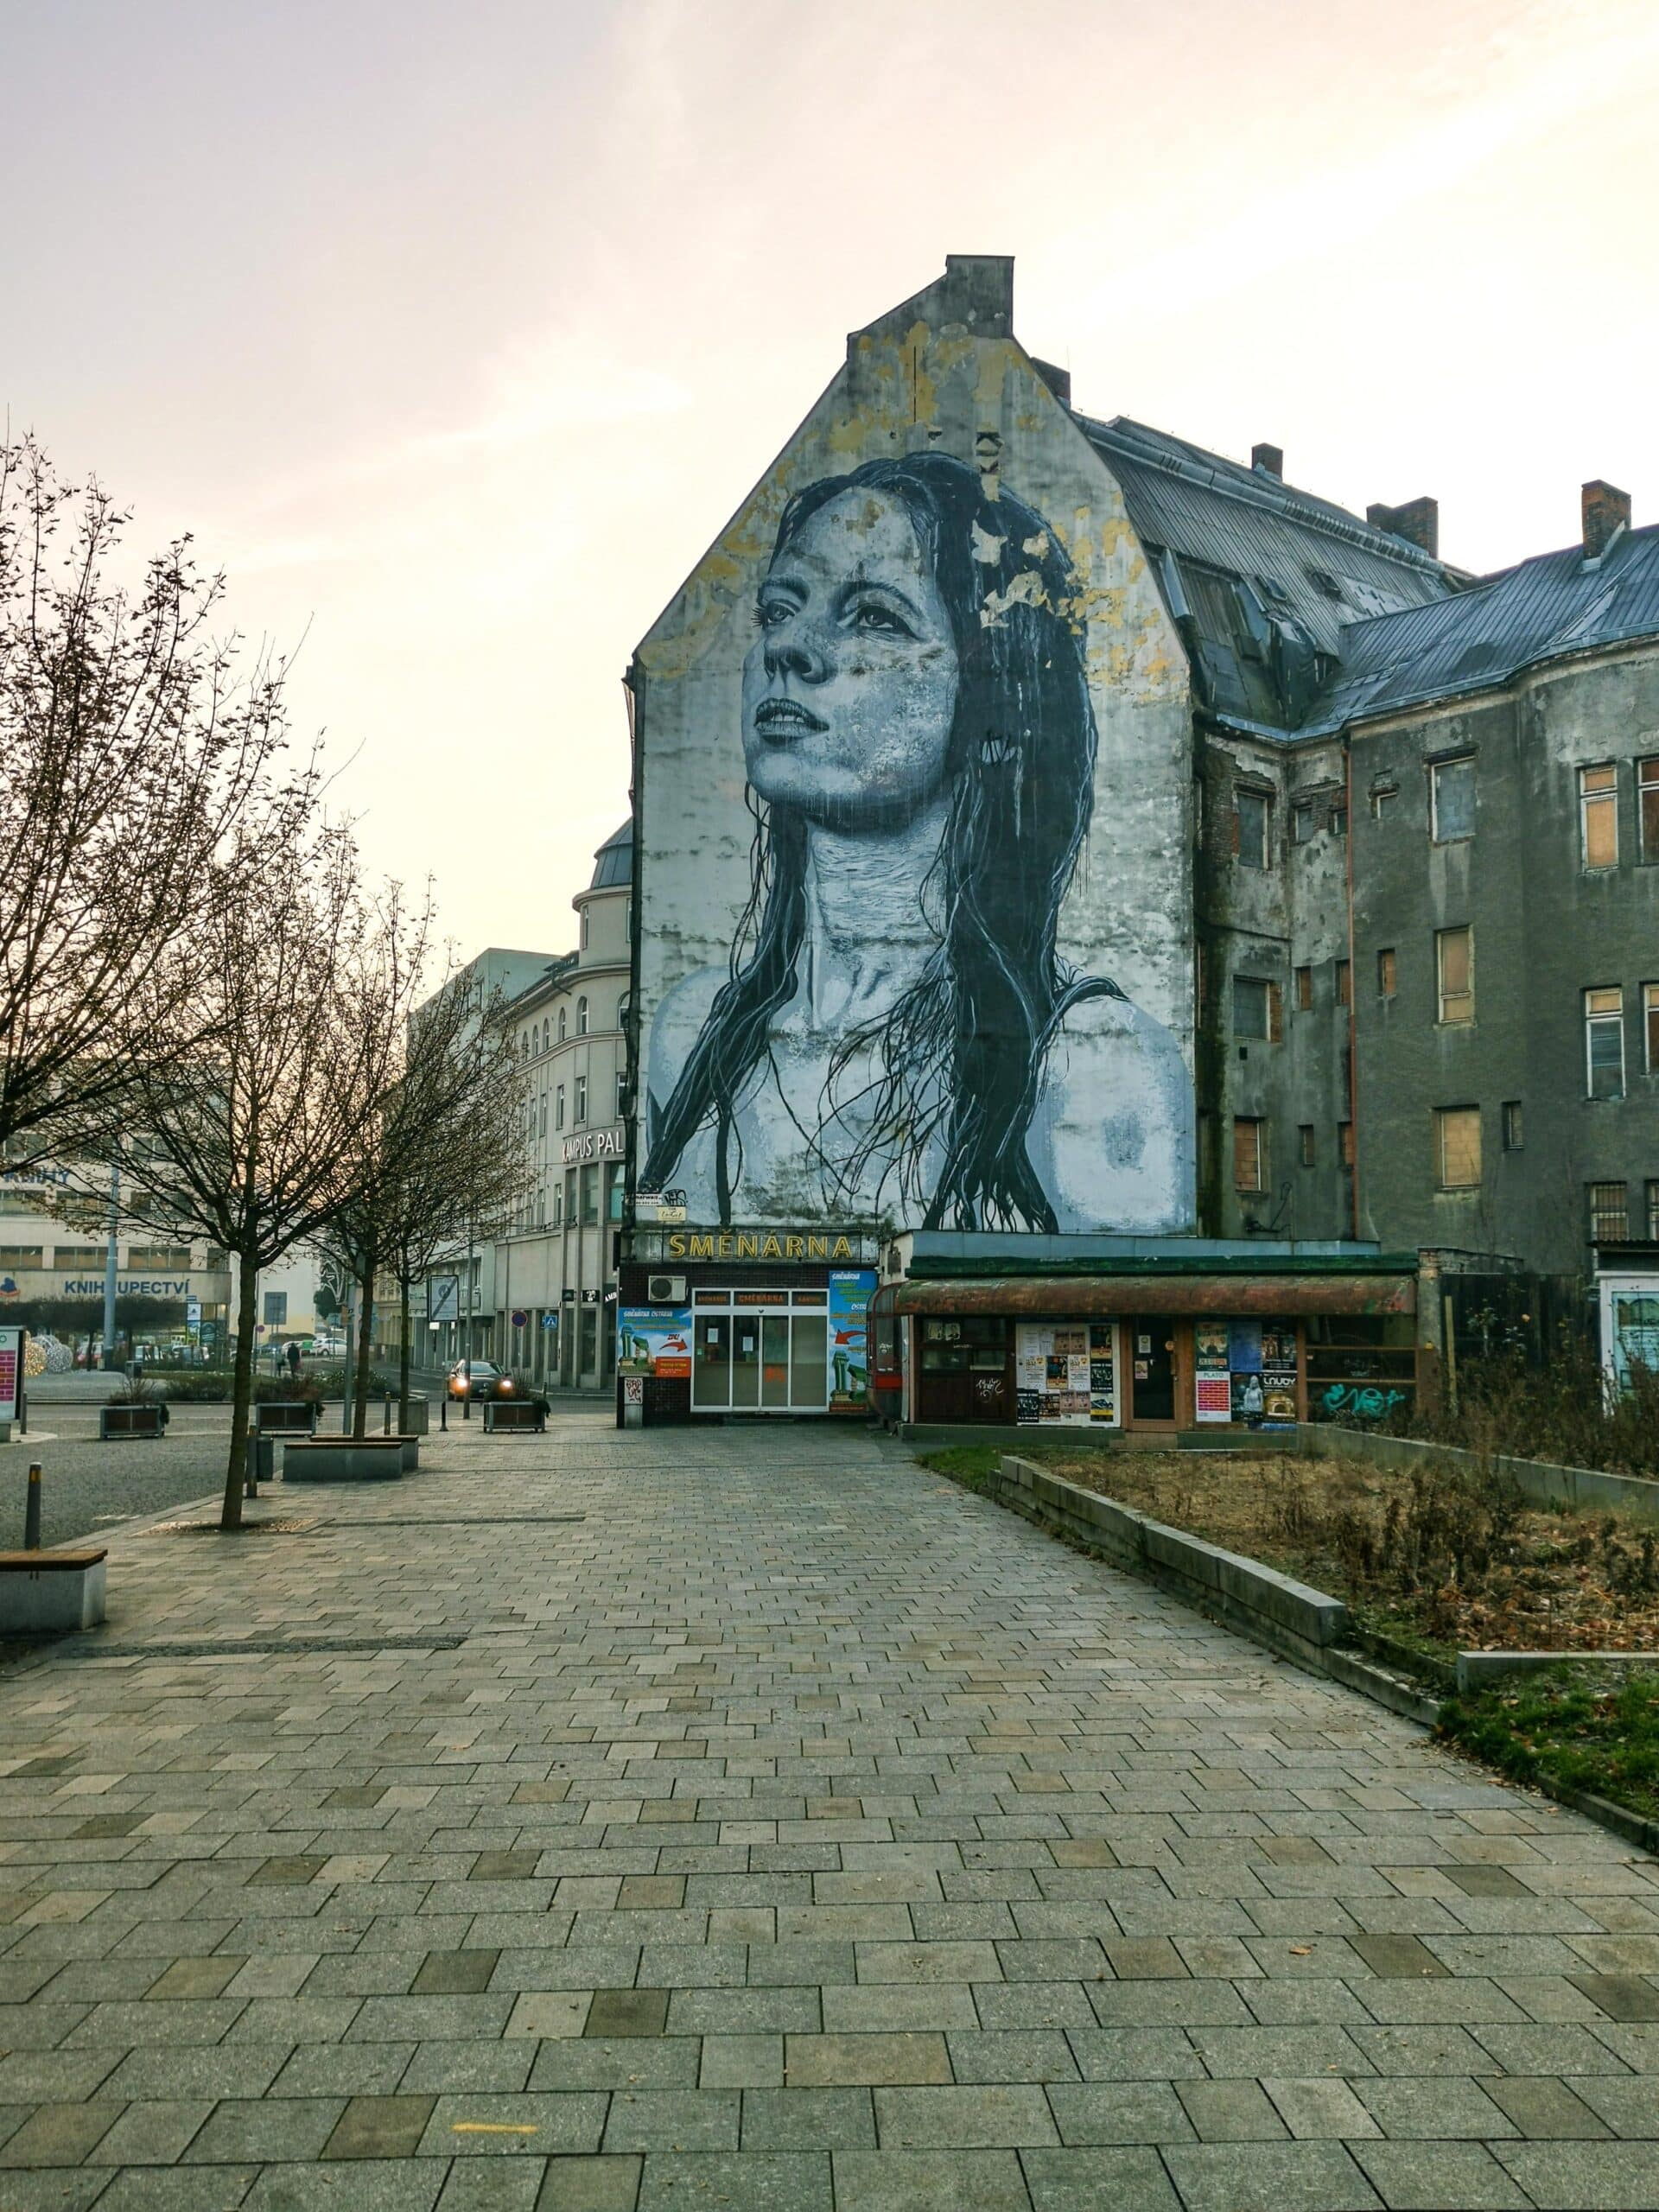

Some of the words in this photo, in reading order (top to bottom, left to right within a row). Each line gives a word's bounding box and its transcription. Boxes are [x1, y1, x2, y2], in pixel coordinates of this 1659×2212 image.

[563, 1135, 592, 1163] KAMPUS
[670, 1229, 853, 1258] SMĚNÁRNA
[65, 1279, 191, 1294] KNIHUPECTVÍ
